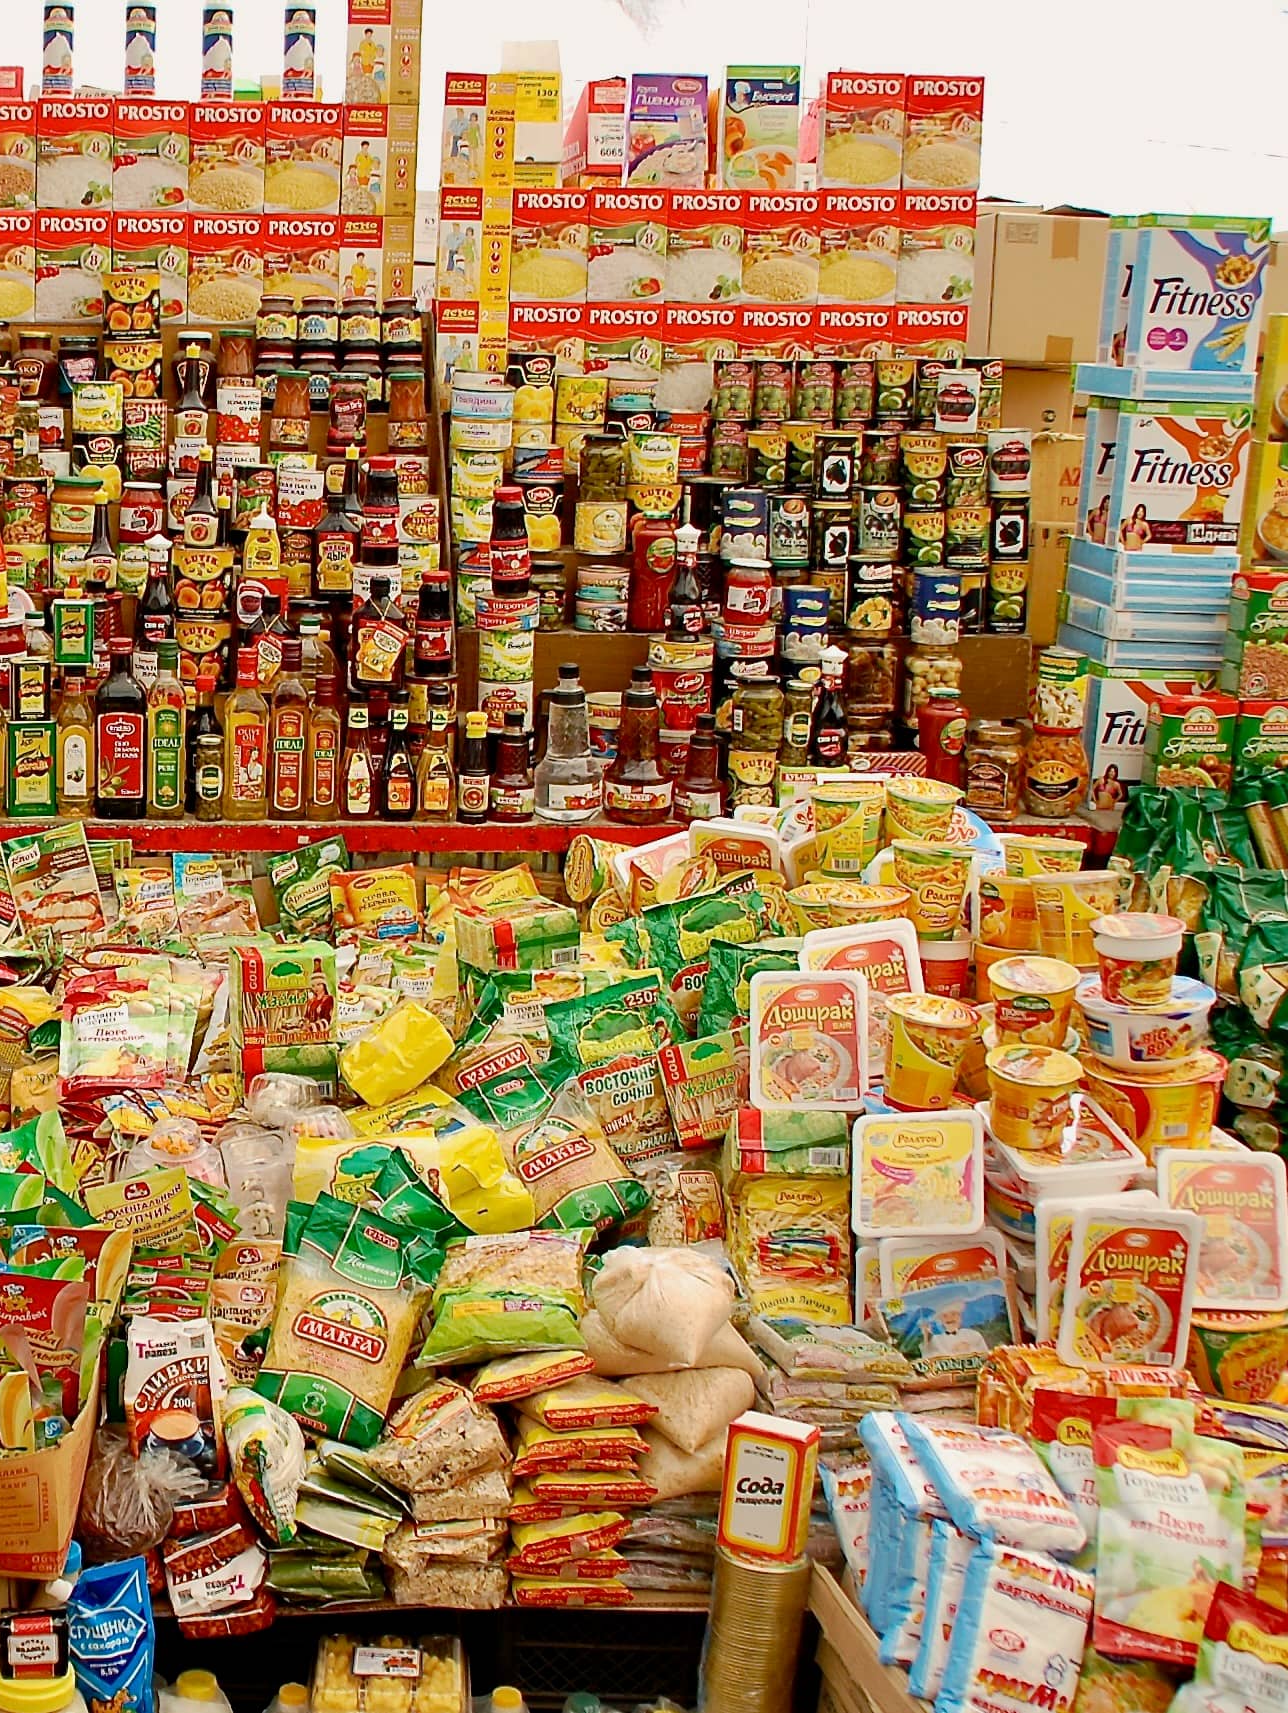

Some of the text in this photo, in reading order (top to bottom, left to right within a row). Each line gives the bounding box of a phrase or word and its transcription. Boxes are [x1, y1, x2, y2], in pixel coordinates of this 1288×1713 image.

[832, 78, 901, 95] PROSTO
[913, 80, 981, 97] PROSTO
[43, 103, 110, 118] PROSTO
[119, 107, 185, 121] PROSTO
[195, 108, 262, 123] PROSTO
[271, 108, 339, 123] PROSTO
[518, 194, 587, 209] PROSTO
[595, 194, 663, 210] PROSTO
[672, 194, 741, 211] PROSTO
[750, 196, 819, 213] PROSTO
[827, 194, 895, 211] PROSTO
[905, 195, 975, 212] PROSTO
[41, 216, 109, 233] PROSTO
[118, 219, 184, 234] PROSTO
[194, 219, 261, 235] PROSTO
[269, 221, 335, 236] PROSTO
[1149, 278, 1254, 318] Fitness
[514, 307, 582, 324] PROSTO
[589, 309, 659, 325] PROSTO
[667, 309, 735, 326] PROSTO
[743, 311, 812, 327] PROSTO
[820, 311, 888, 327] PROSTO
[897, 311, 966, 327] PROSTO
[1128, 448, 1233, 487] Fitness
[184, 555, 218, 566] LUTIK
[182, 627, 217, 638] LUTIK
[154, 738, 180, 747] IDEAL
[275, 739, 302, 750] IDEAL
[12, 850, 38, 866] Knorr
[249, 959, 258, 988] GOLD
[764, 1005, 854, 1031] Доширак
[1140, 1026, 1171, 1046] BIG
[666, 1050, 680, 1080] GOLD
[114, 1205, 171, 1229] СУПЧИК
[1086, 1246, 1184, 1275] Доширак
[134, 1357, 209, 1412] СЛИВКИ
[737, 1477, 784, 1494] Сода
[70, 1619, 136, 1640] СГУЩЕНКА
[88, 1638, 130, 1650] сахаром
